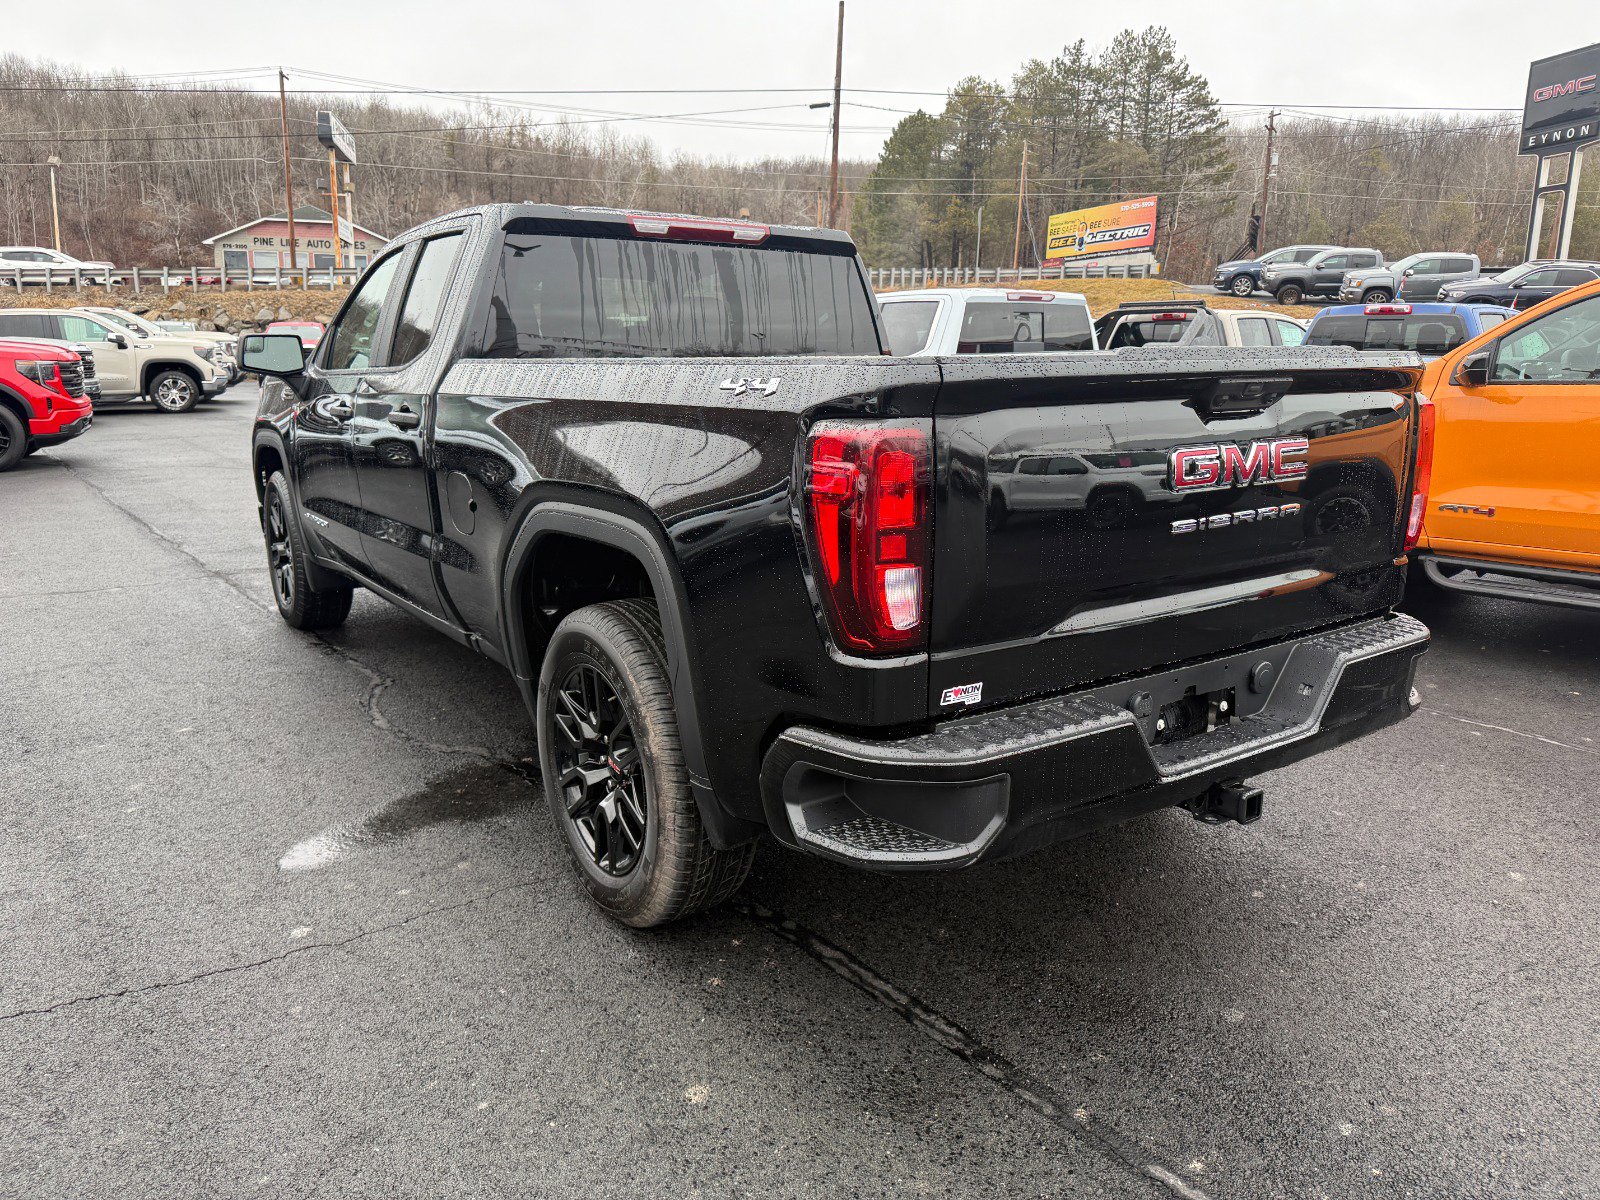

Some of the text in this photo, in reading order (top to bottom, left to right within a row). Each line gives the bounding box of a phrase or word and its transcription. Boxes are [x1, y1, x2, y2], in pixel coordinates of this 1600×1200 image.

[1533, 74, 1597, 102] GMC
[1528, 124, 1590, 146] EYNON
[1049, 217, 1121, 236] BEE SAFE BEE SURE
[253, 237, 366, 250] PINE LIE AUTO SAES
[1049, 236, 1077, 249] BEE
[1167, 436, 1309, 494] GMC
[1170, 503, 1301, 534] SIERRA
